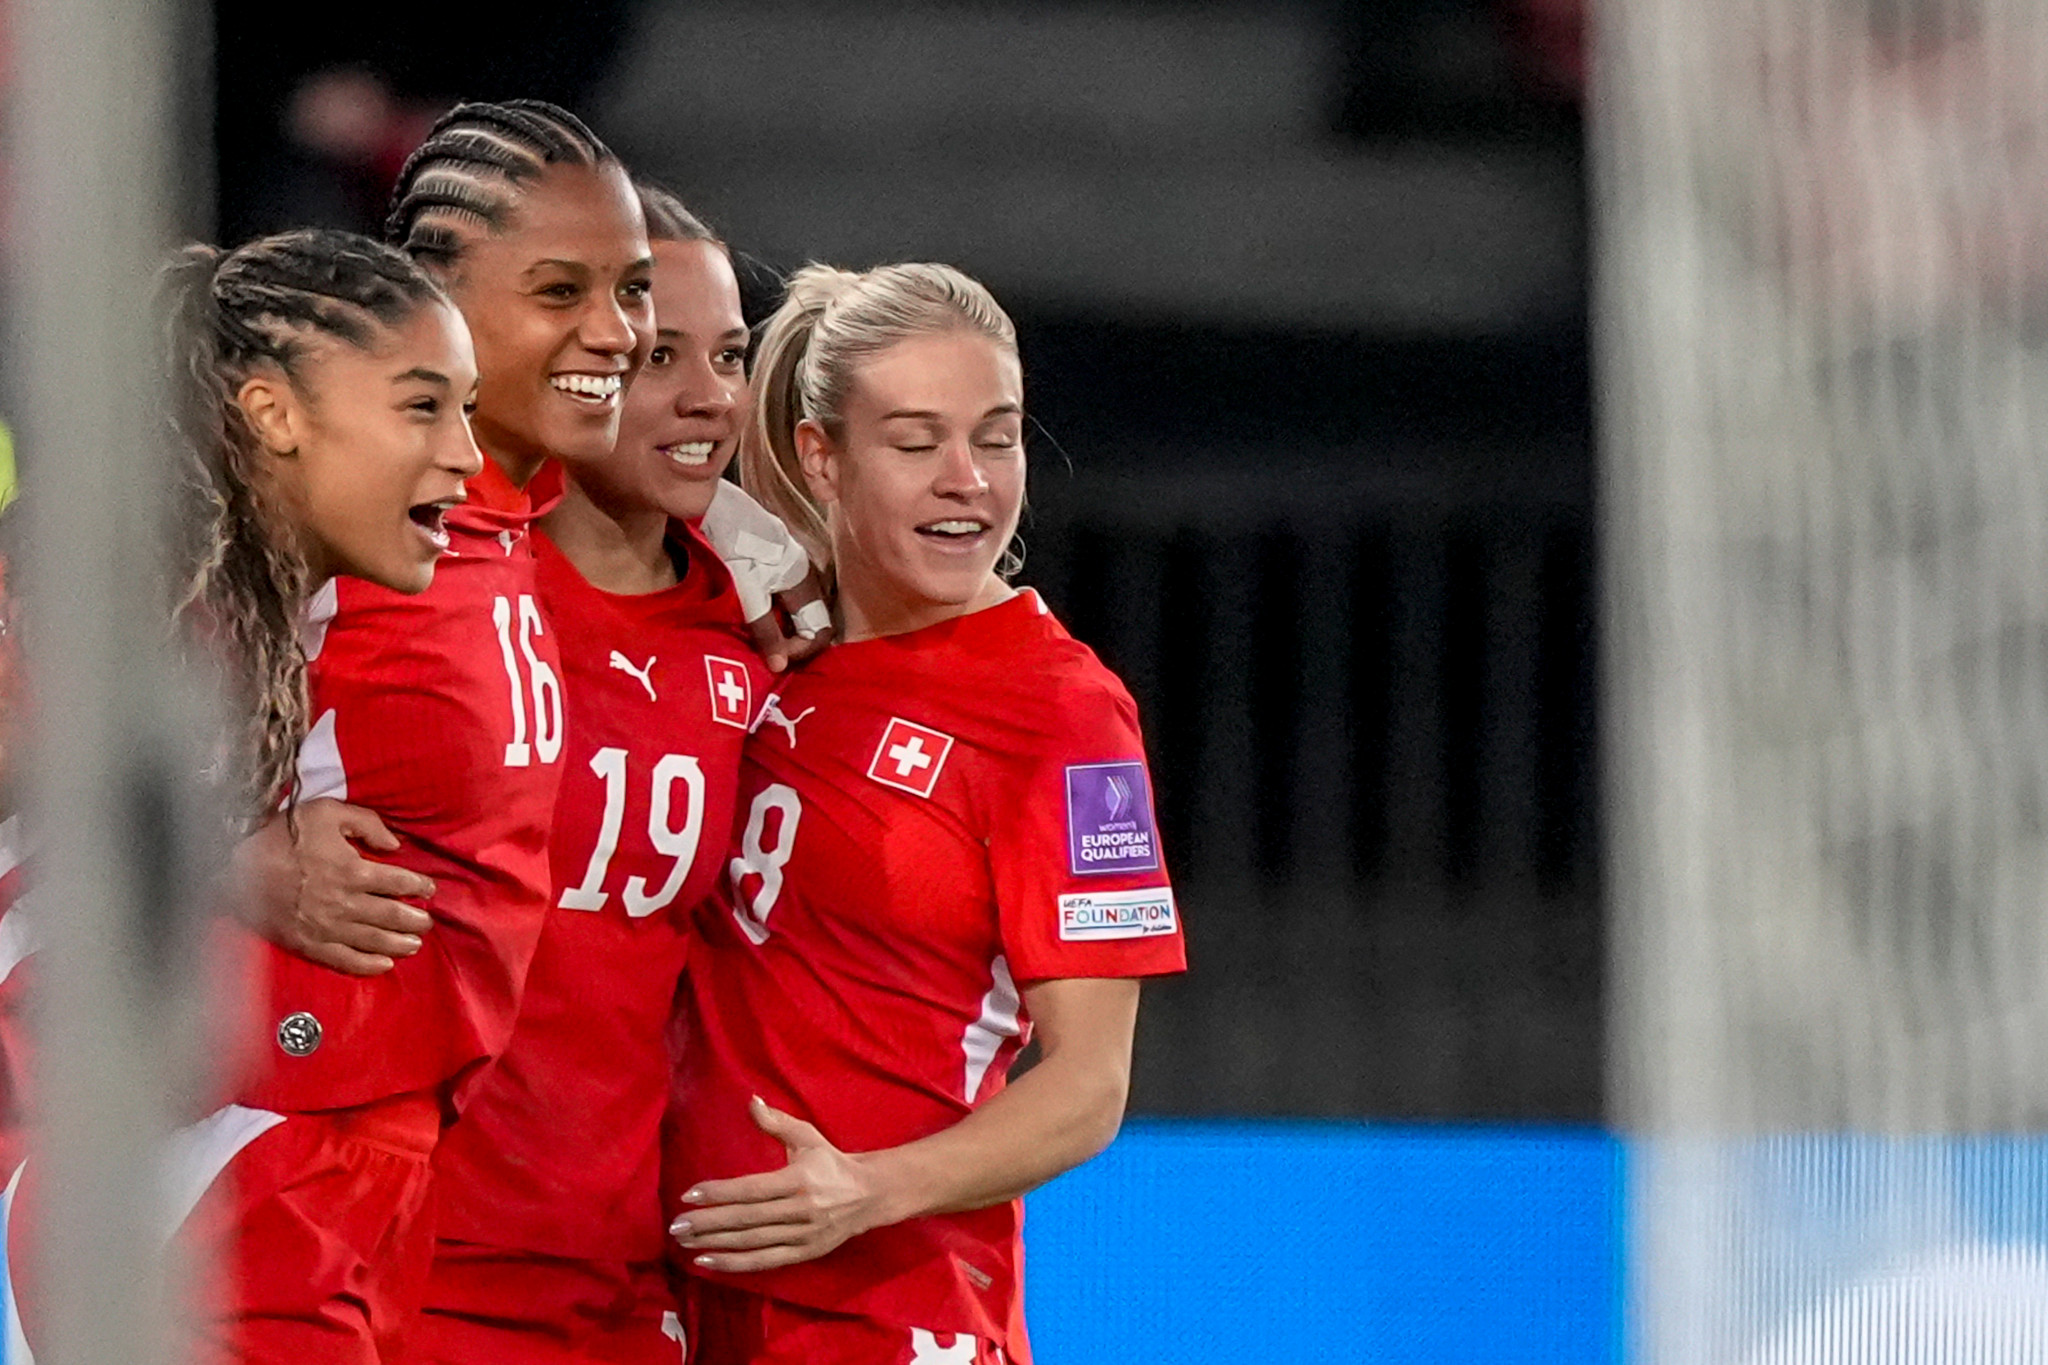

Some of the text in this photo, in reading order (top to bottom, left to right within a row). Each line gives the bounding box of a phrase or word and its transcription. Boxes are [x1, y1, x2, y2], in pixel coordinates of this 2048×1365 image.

[493, 594, 563, 767] 16
[557, 746, 705, 917] 19
[729, 783, 802, 945] 8
[1080, 844, 1150, 863] QUALIFIERS
[1081, 831, 1149, 848] EUROPEAN
[1064, 904, 1171, 925] FOUNDATION
